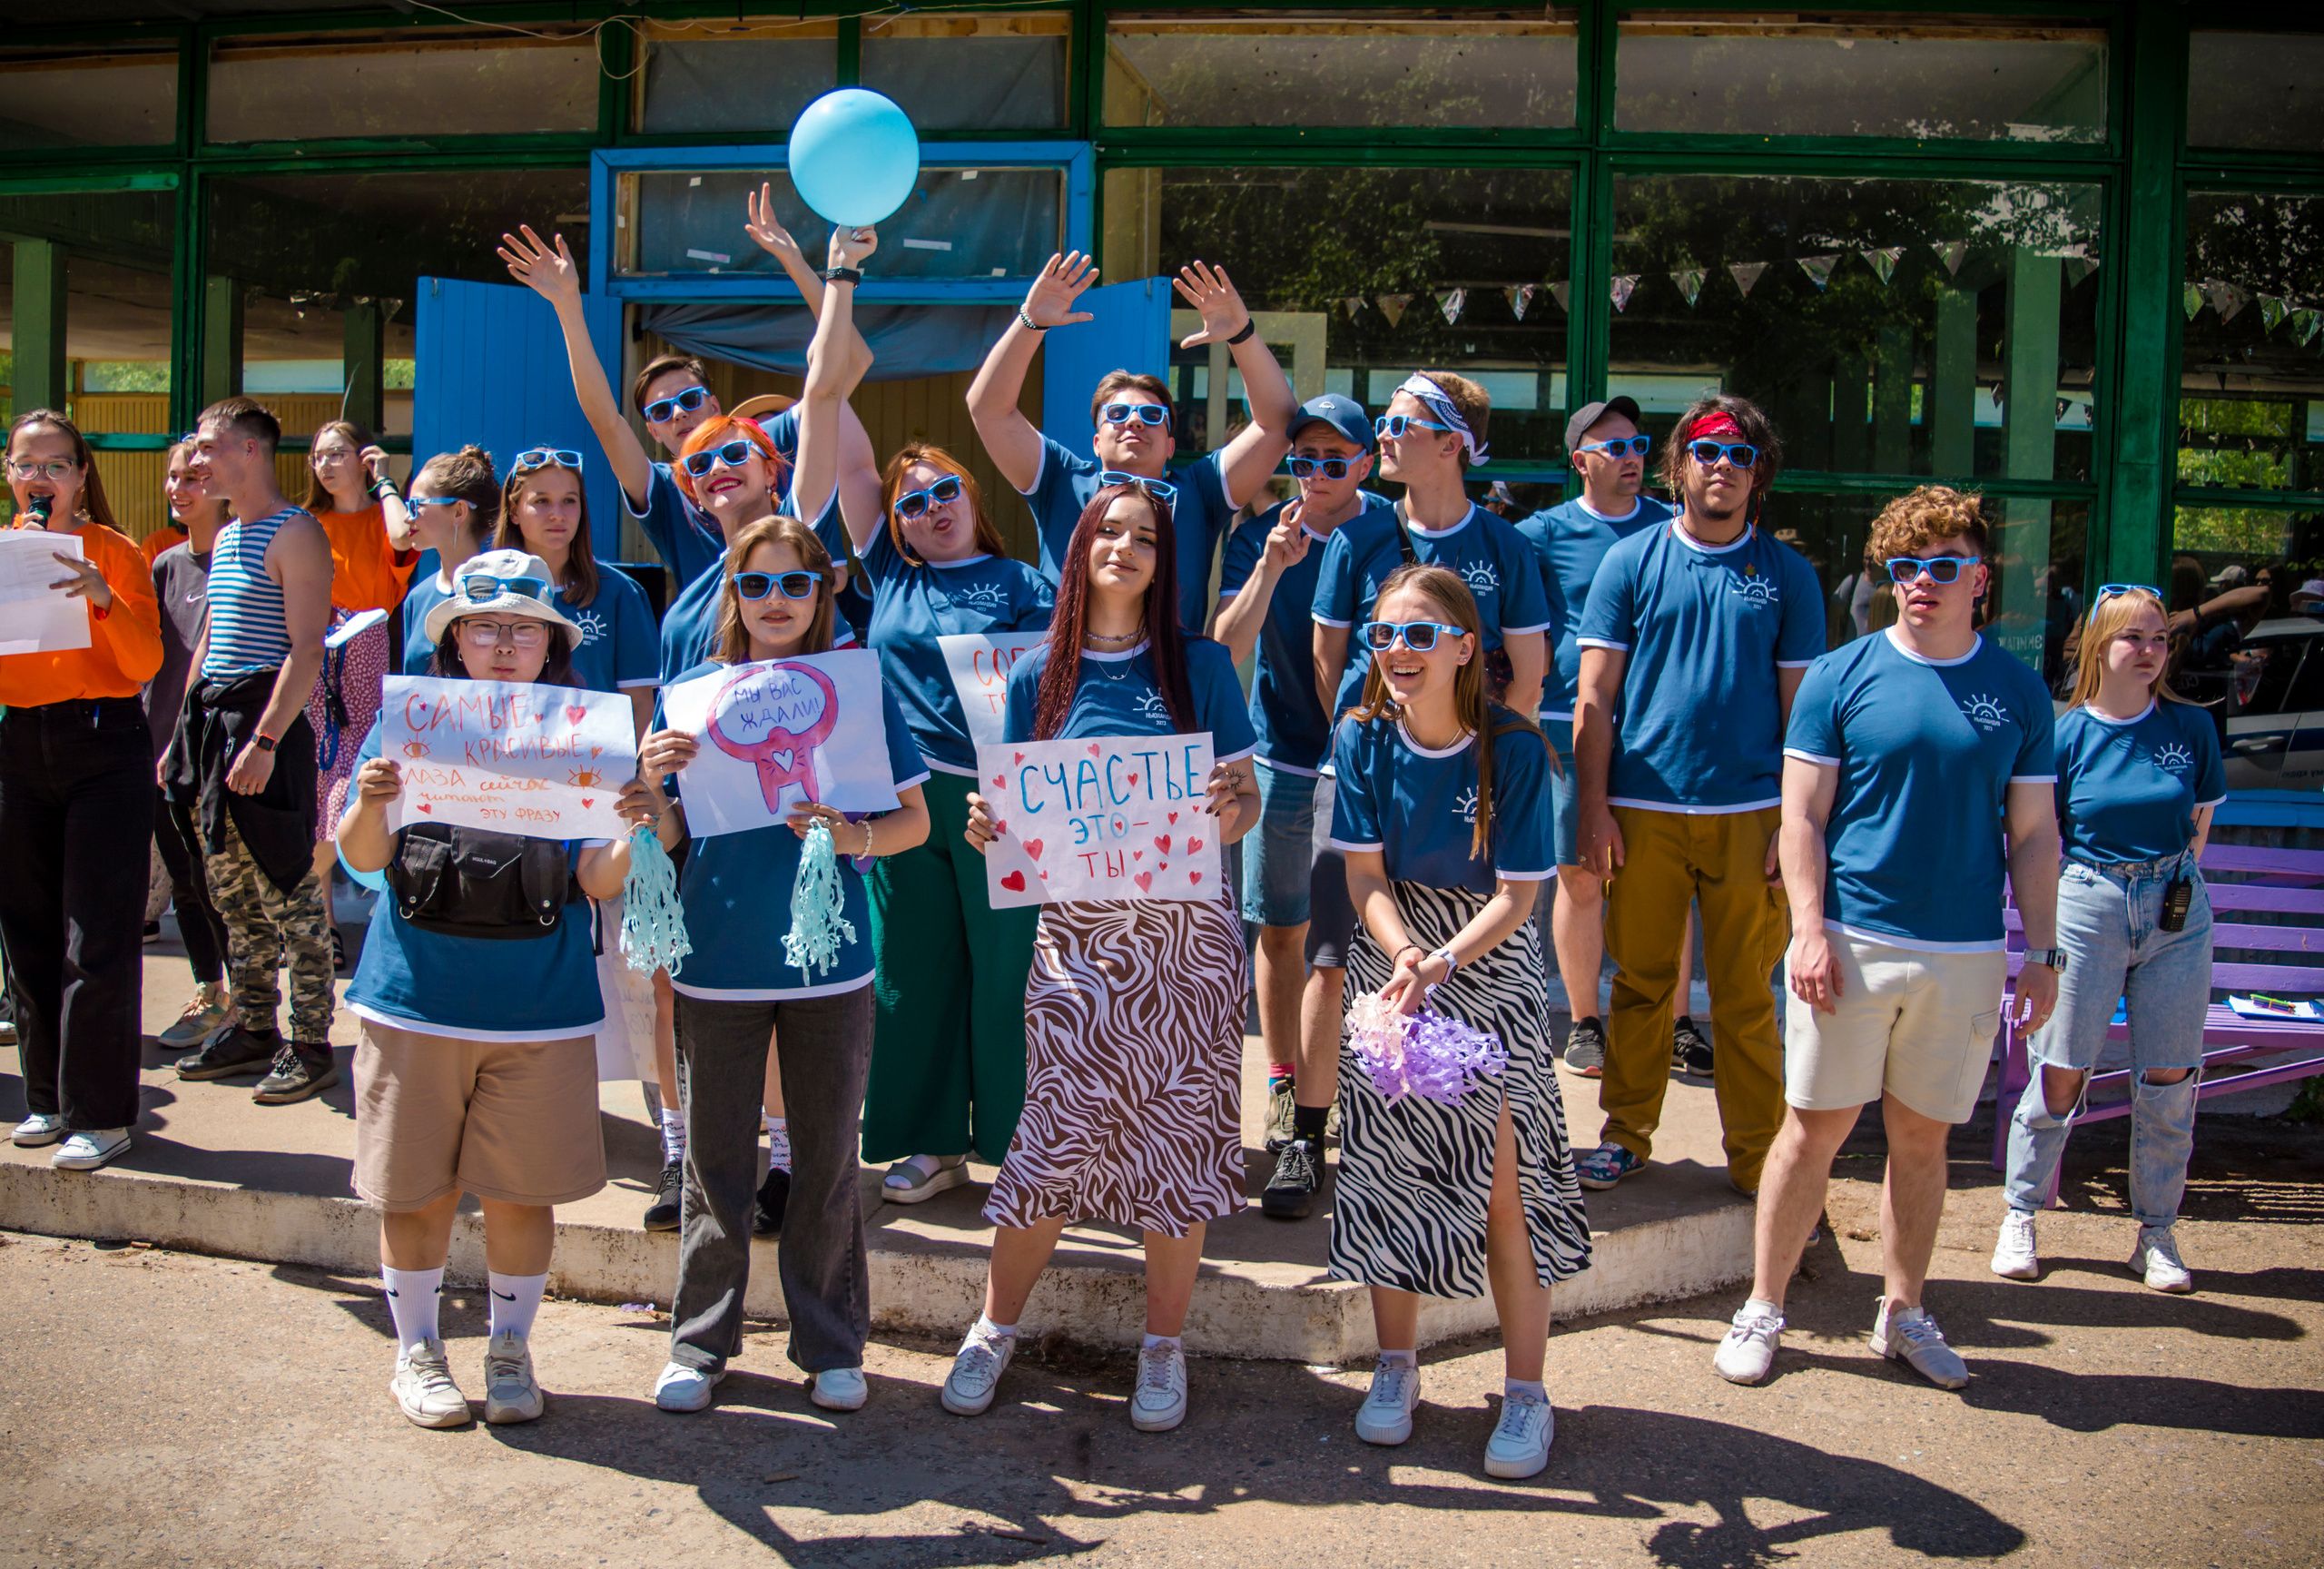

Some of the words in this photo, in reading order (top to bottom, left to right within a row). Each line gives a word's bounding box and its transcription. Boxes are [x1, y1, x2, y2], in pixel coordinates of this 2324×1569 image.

[734, 686, 761, 706] МЫ
[769, 677, 803, 700] ВАС
[406, 693, 527, 732] САМЫЕ
[741, 696, 822, 733] ЖДАЛИ!
[465, 733, 584, 768] КРАСИВЫЕ
[405, 768, 467, 787] ЛАЗА
[479, 775, 552, 792] сейчас
[1019, 745, 1206, 814] СЧАСТЬЕ
[417, 792, 507, 804] читают
[479, 808, 507, 820] ЭТУ
[514, 806, 561, 824] ФРАЗУ
[1077, 848, 1126, 878] ТЫ
